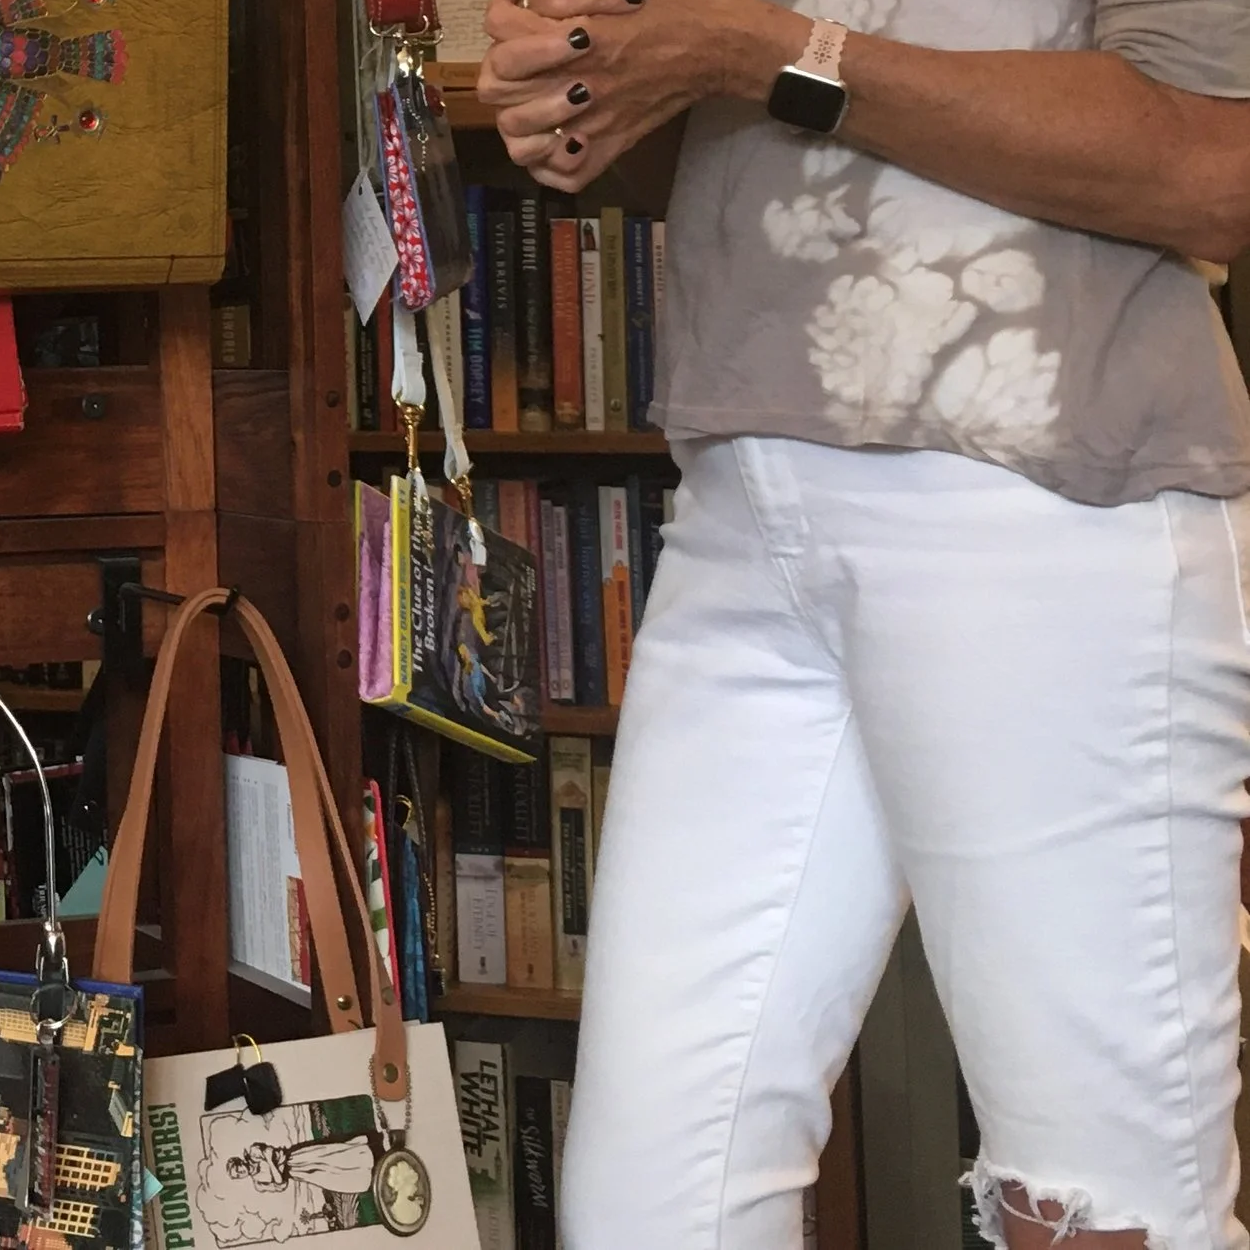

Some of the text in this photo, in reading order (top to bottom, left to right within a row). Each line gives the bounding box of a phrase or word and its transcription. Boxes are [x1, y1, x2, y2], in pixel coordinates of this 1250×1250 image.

[520, 199, 537, 271] RODDY DOYLE
[493, 223, 507, 310] VITA BREVIS
[466, 327, 482, 351] TIM
[468, 354, 484, 404] DORSEY
[410, 553, 422, 579] of
[399, 585, 408, 630] DREW
[410, 582, 423, 631] Clue
[423, 576, 436, 649] Broken
[400, 632, 409, 684] NANCY
[411, 633, 424, 671] The
[459, 1071, 482, 1158] WHITE
[477, 1059, 498, 1146] LETHAL
[147, 1102, 196, 1249] PIONEERS!
